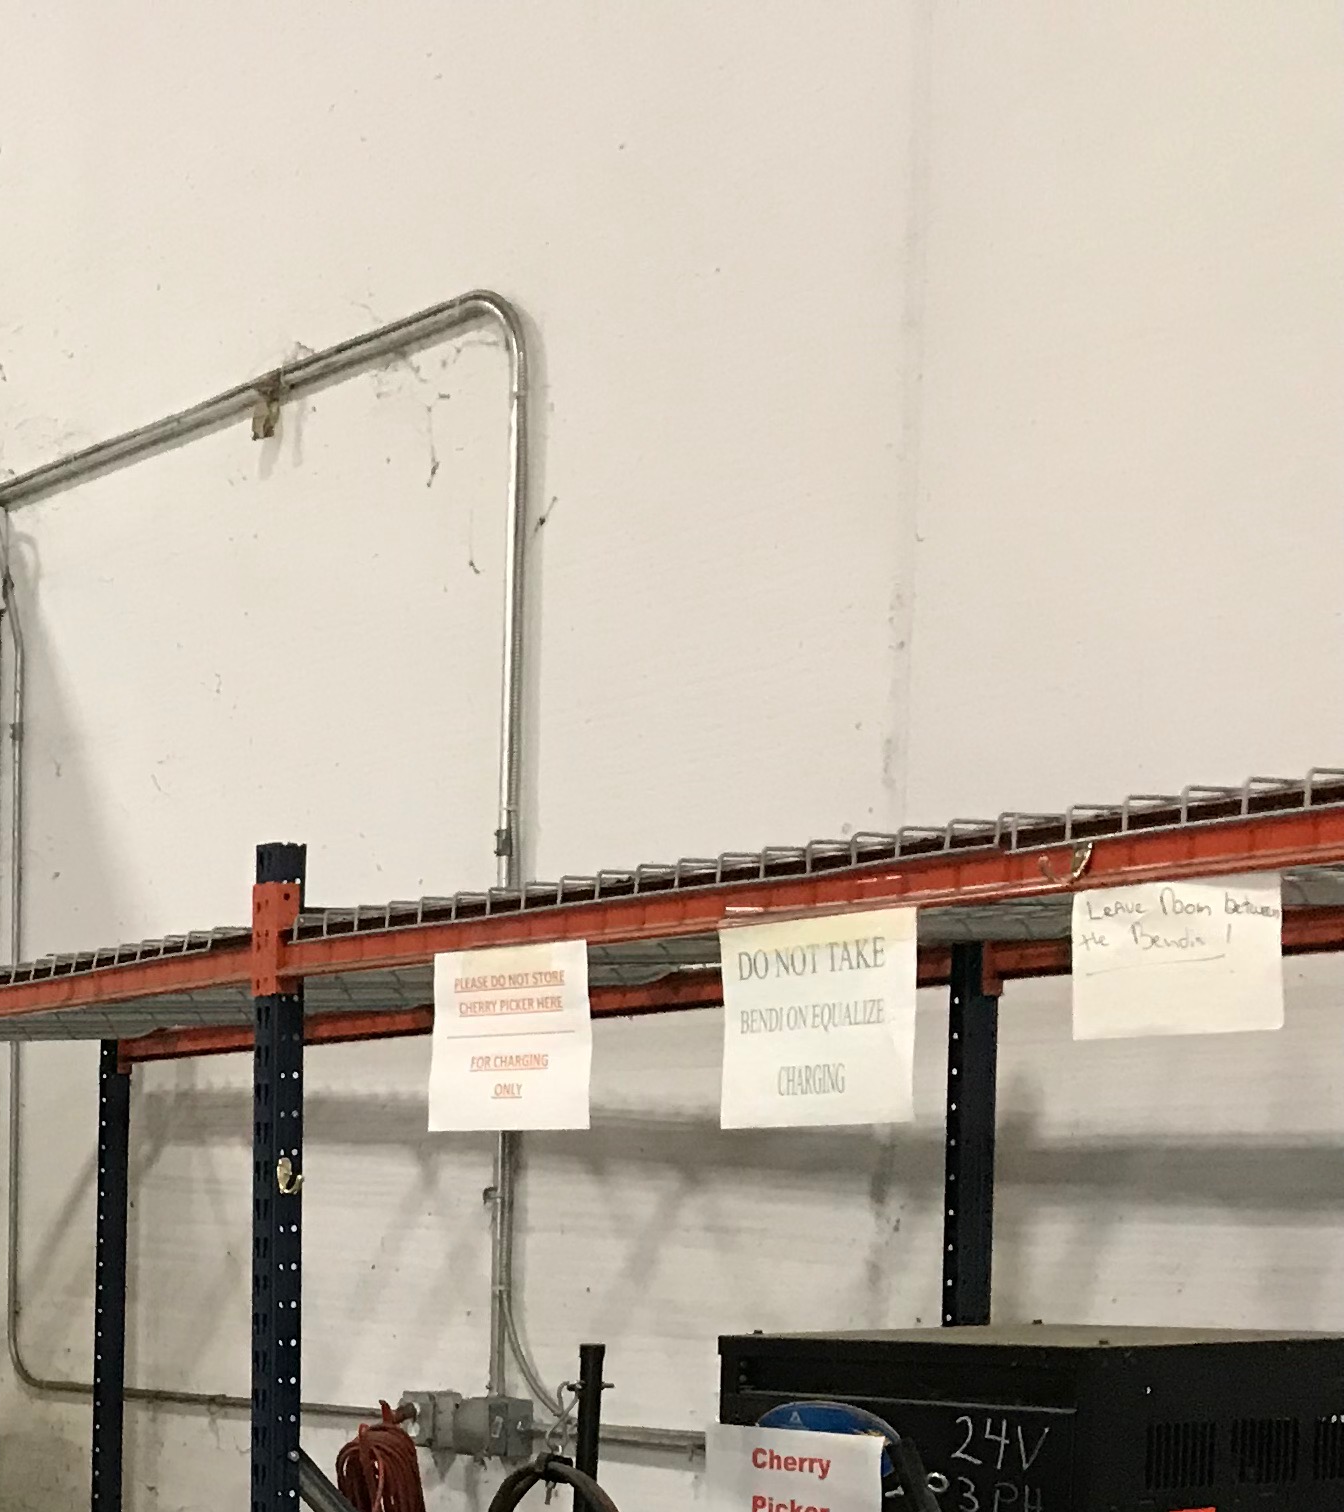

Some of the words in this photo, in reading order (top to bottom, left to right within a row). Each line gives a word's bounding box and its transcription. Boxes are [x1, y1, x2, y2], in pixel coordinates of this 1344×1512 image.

[738, 948, 769, 981] DO
[775, 943, 818, 978] NOT
[824, 936, 886, 972] TAKE
[454, 972, 488, 991] PLEASE
[491, 973, 506, 987] DO
[508, 972, 530, 987] NOT
[532, 969, 565, 986] STORE
[459, 1000, 497, 1015] CHERRY
[500, 998, 533, 1013] PICKER
[536, 995, 563, 1010] HERE
[740, 1008, 783, 1034] BENDI
[787, 1004, 809, 1030] ON
[810, 998, 885, 1033] EQUALIZE
[470, 1055, 491, 1070] FOR
[493, 1053, 549, 1069] CHARGING
[494, 1082, 523, 1097] ONLY
[777, 1062, 846, 1096] CHARGING
[751, 1447, 832, 1480] Cherry
